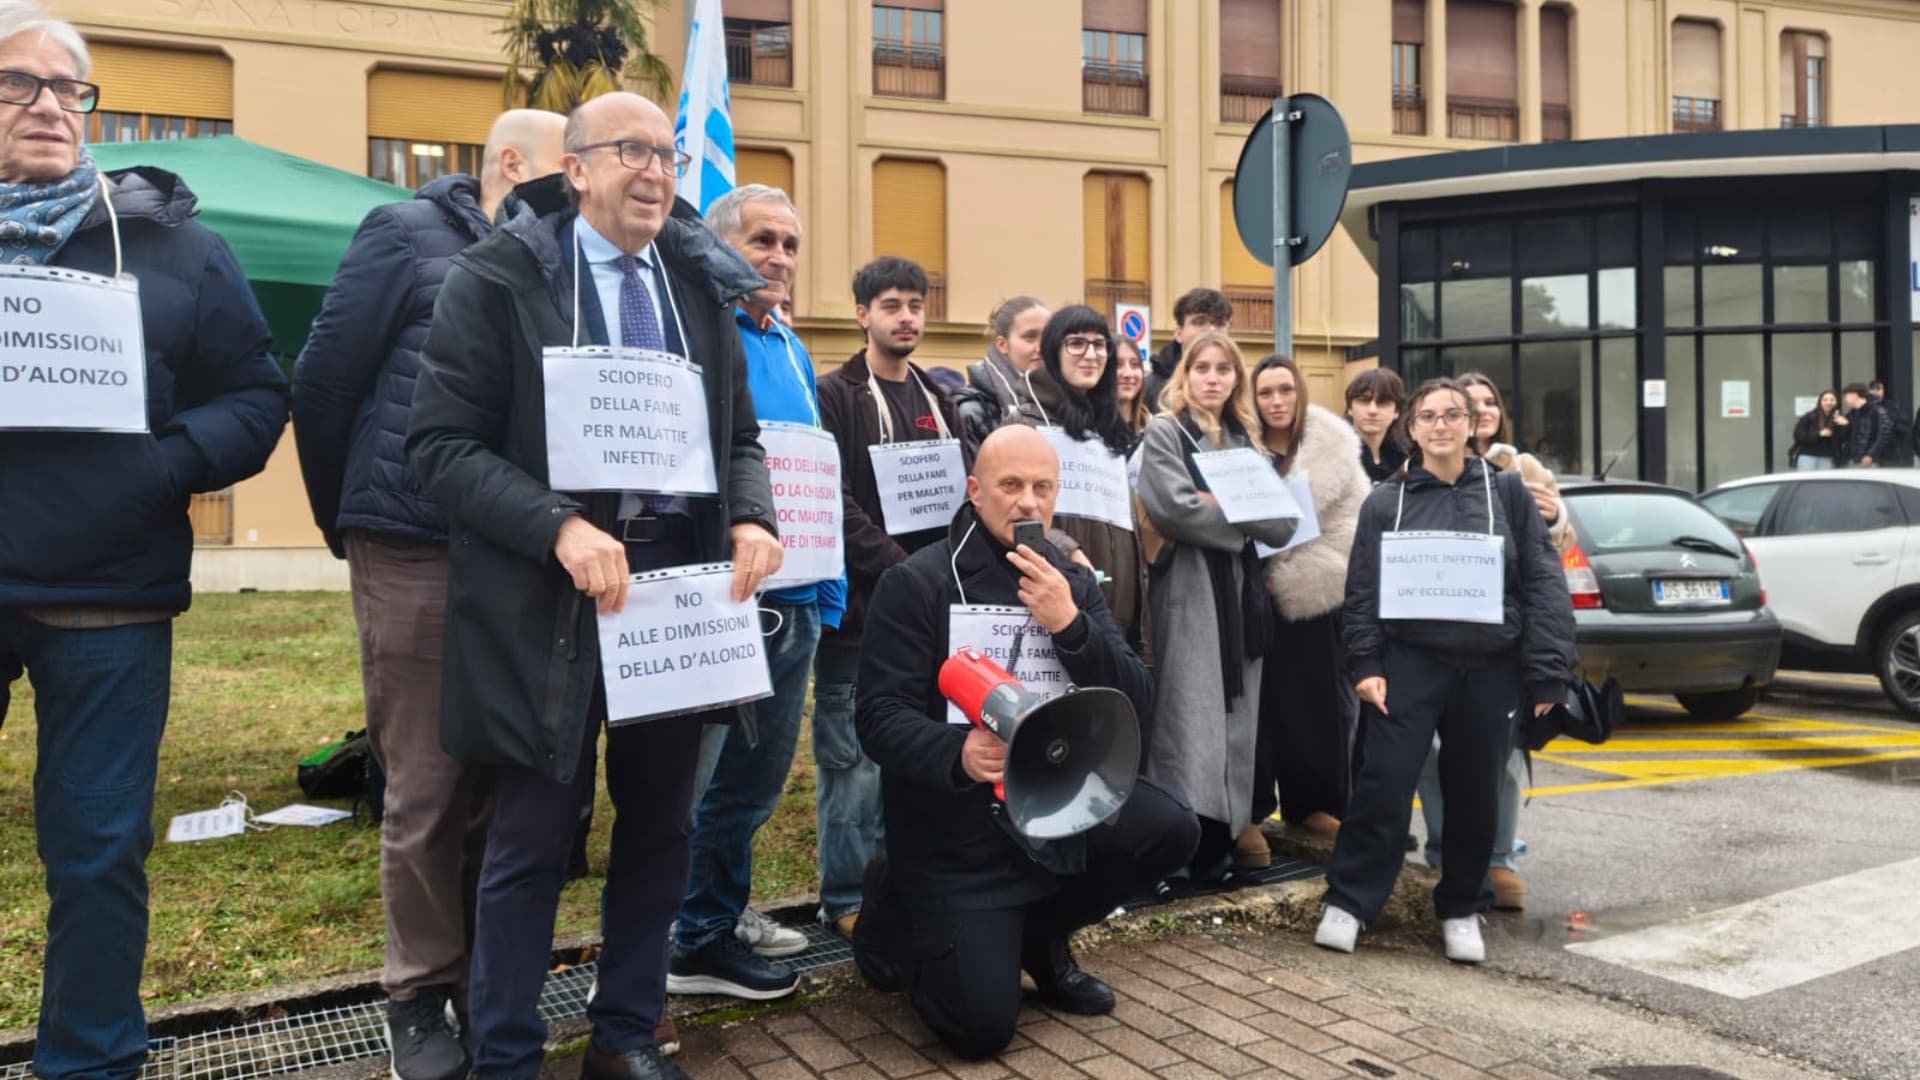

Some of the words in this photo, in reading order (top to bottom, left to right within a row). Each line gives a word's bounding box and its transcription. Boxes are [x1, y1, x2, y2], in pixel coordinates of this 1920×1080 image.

[4, 296, 41, 314] NO
[0, 330, 123, 354] IMISSIONI
[598, 369, 673, 389] SCIOPERO
[590, 396, 640, 412] DELLA
[644, 399, 681, 417] FAME
[583, 424, 614, 438] PER
[619, 425, 688, 445] MALATTIE
[603, 450, 678, 468] INFETTIVE
[794, 458, 818, 473] DELLA
[819, 460, 837, 476] FAME
[900, 453, 940, 466] SCIOPERO
[897, 471, 924, 484] DELLA
[925, 469, 948, 480] FAME
[788, 483, 801, 497] LA
[897, 491, 914, 501] PER
[915, 485, 955, 499] MALATTIE
[909, 502, 950, 516] INFETTIVE
[798, 510, 834, 525] MALATTIE
[798, 535, 809, 549] DI
[1386, 554, 1440, 565] MALATTIE
[1443, 554, 1497, 566] INFETTIVE
[675, 592, 703, 609] NO
[1419, 587, 1487, 599] ECCELLENZA
[617, 628, 660, 649] ALLE
[664, 615, 750, 641] DIMISSIONI
[1028, 649, 1057, 661] FAME
[619, 657, 676, 680] DELLA
